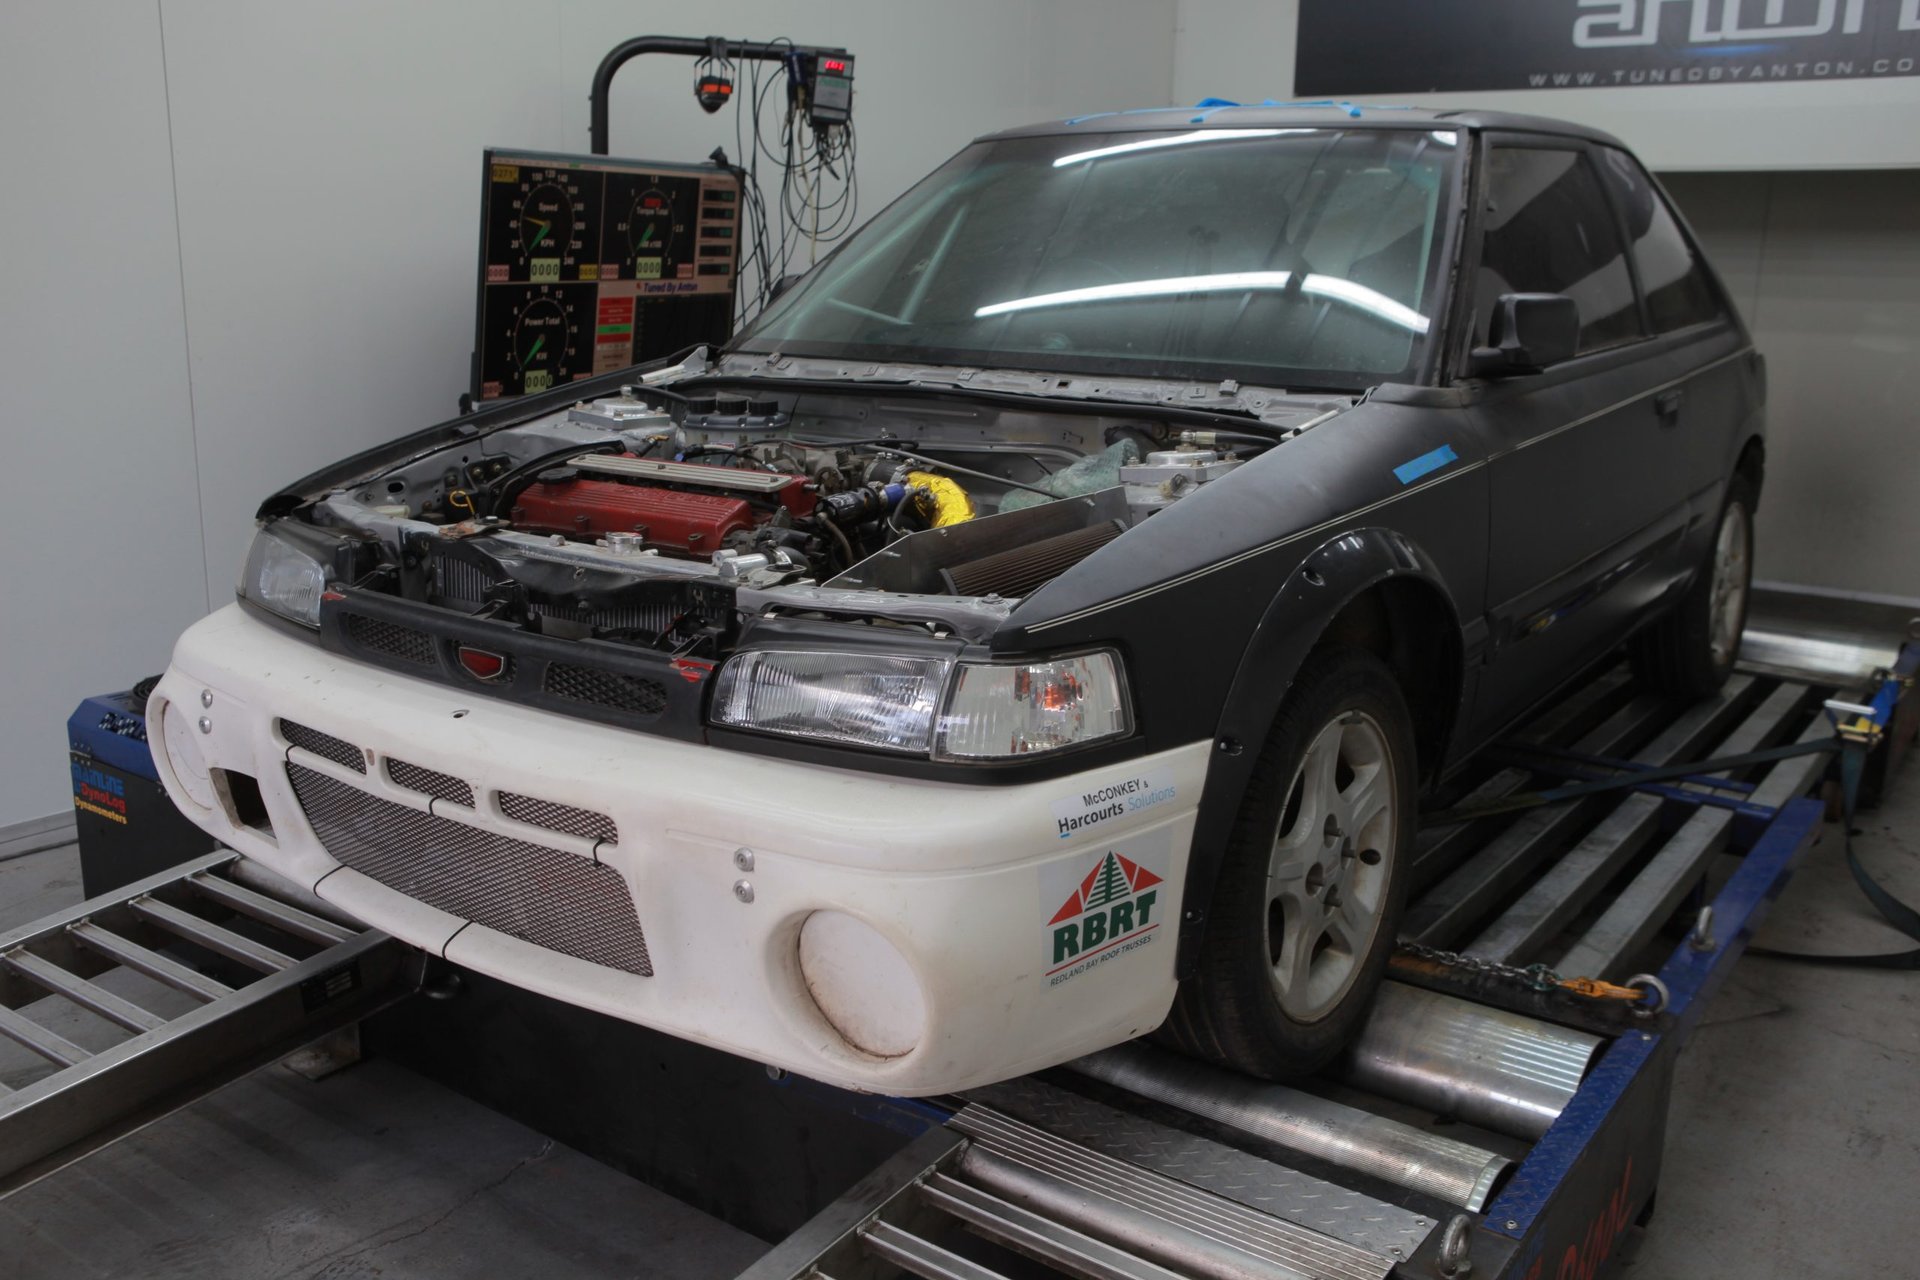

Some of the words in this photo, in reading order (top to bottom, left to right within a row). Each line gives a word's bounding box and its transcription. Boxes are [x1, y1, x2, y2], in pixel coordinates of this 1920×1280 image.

[531, 264, 559, 276] 0000
[637, 262, 660, 273] 0000
[644, 283, 666, 293] Tuned
[524, 318, 544, 326] Power
[545, 317, 560, 325] Total
[1083, 778, 1140, 808] McCONKEY
[74, 796, 128, 825] Dynamometers
[1058, 802, 1124, 834] Harcourts
[1127, 785, 1176, 812] Solutions
[1053, 889, 1157, 965] RBRT
[1050, 964, 1085, 988] REDLAND
[1085, 956, 1100, 971] BAY
[1100, 947, 1121, 964] ROOF
[1121, 934, 1152, 954] TRUSSES
